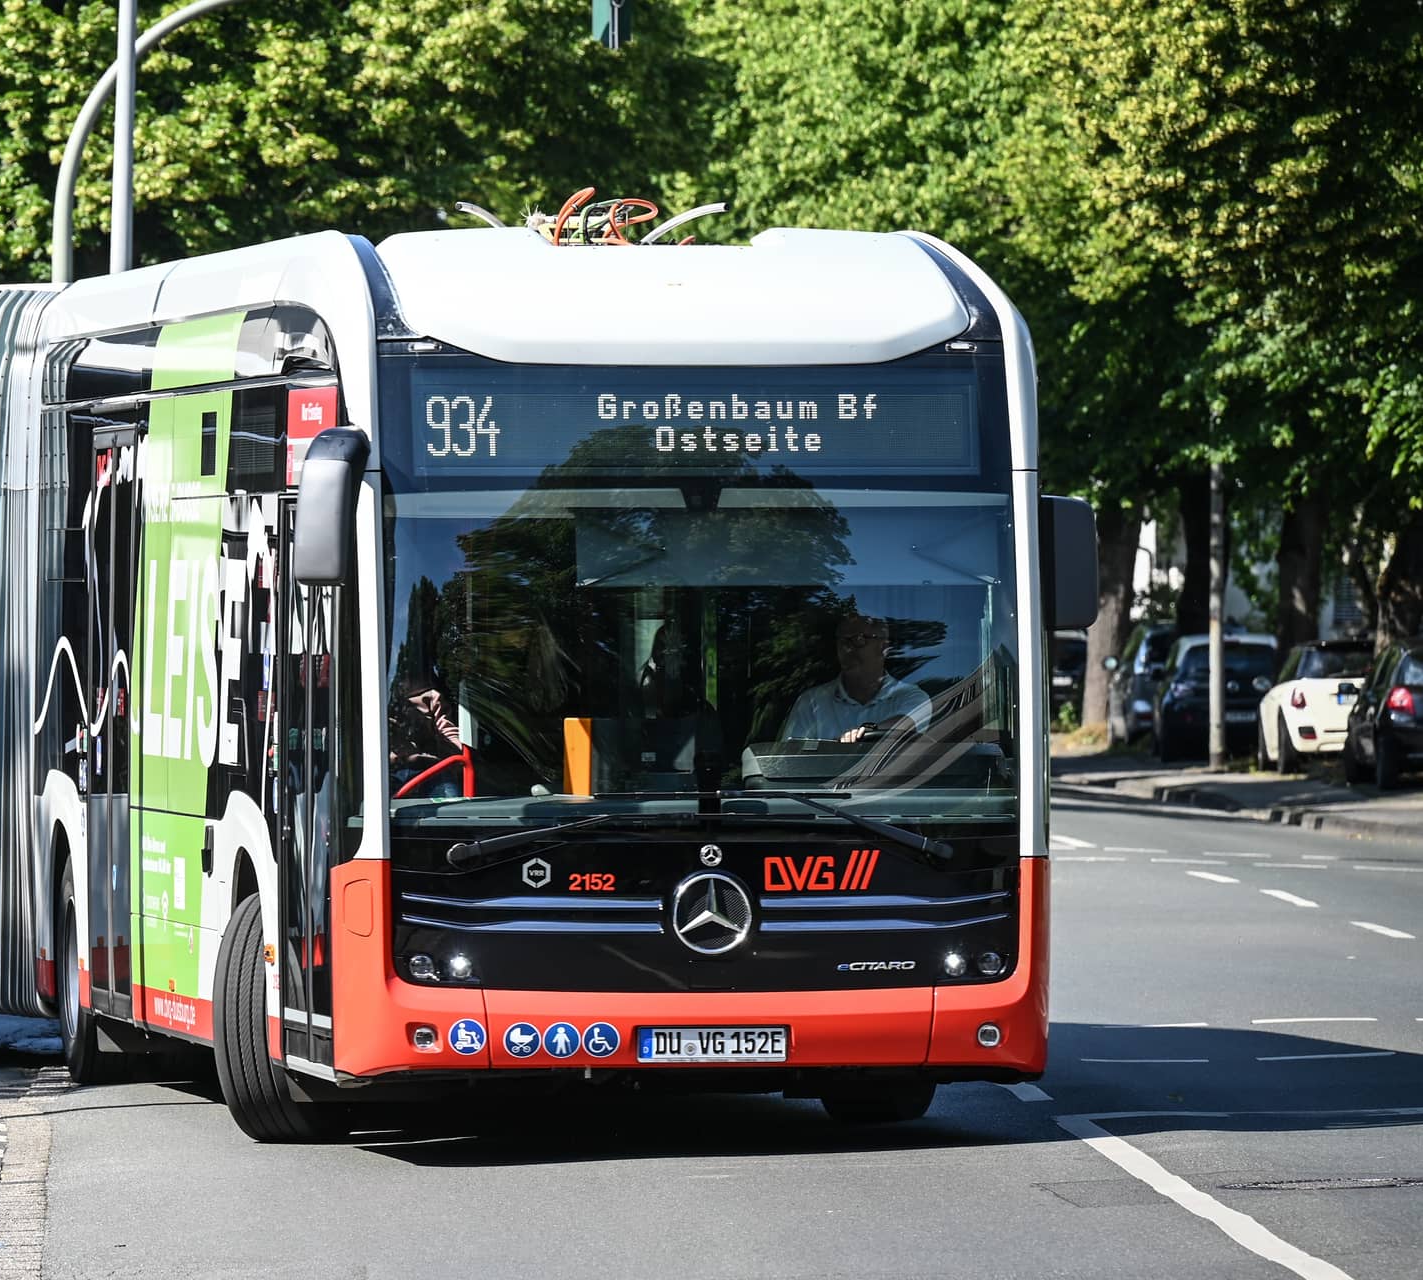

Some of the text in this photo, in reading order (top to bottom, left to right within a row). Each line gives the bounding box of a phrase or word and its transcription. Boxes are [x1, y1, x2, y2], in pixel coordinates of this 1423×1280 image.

[598, 394, 877, 419] Großenbaum Bf
[426, 396, 500, 456] 934
[656, 426, 822, 451] Ostseite
[529, 869, 545, 877] VRR
[569, 873, 615, 890] 2152
[764, 856, 835, 891] DVG
[837, 961, 916, 971] eCITARO
[655, 1031, 783, 1055] DU VG 152E
